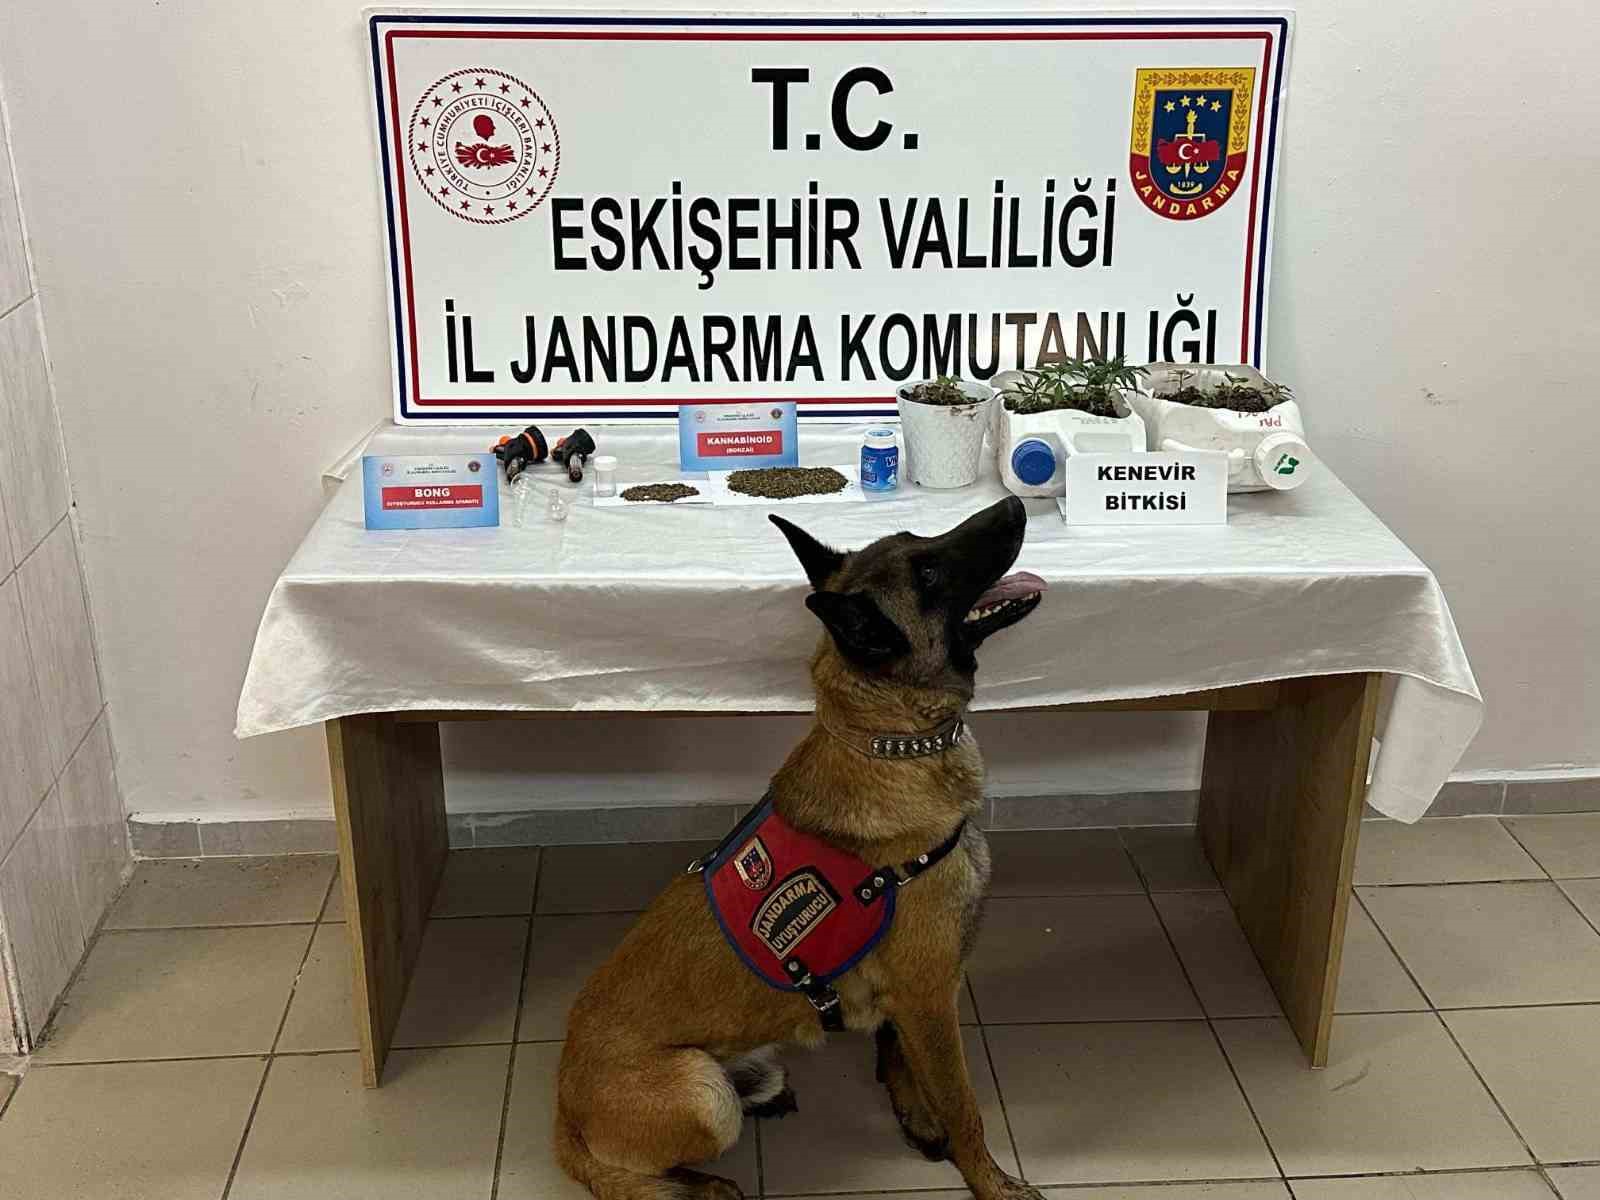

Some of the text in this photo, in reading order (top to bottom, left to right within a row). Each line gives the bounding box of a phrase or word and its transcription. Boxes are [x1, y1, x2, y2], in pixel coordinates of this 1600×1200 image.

[751, 66, 919, 151] T.C.
[435, 97, 533, 192] TÜRKİYE CUMHURİYETİ İÇİŞLERİ BAKANLIĞI
[1135, 169, 1240, 216] JANDARMA
[551, 177, 1117, 291] ESKİŞEHİR VALİLİĞİ
[444, 298, 495, 384] İL
[510, 314, 825, 384] JANDARMA
[706, 435, 774, 446] KANNABİNOİD
[414, 487, 451, 498] BONG
[1097, 461, 1196, 481] KENEVİR
[1104, 492, 1187, 511] BİTKİSİ
[758, 880, 818, 938] JANDARMA
